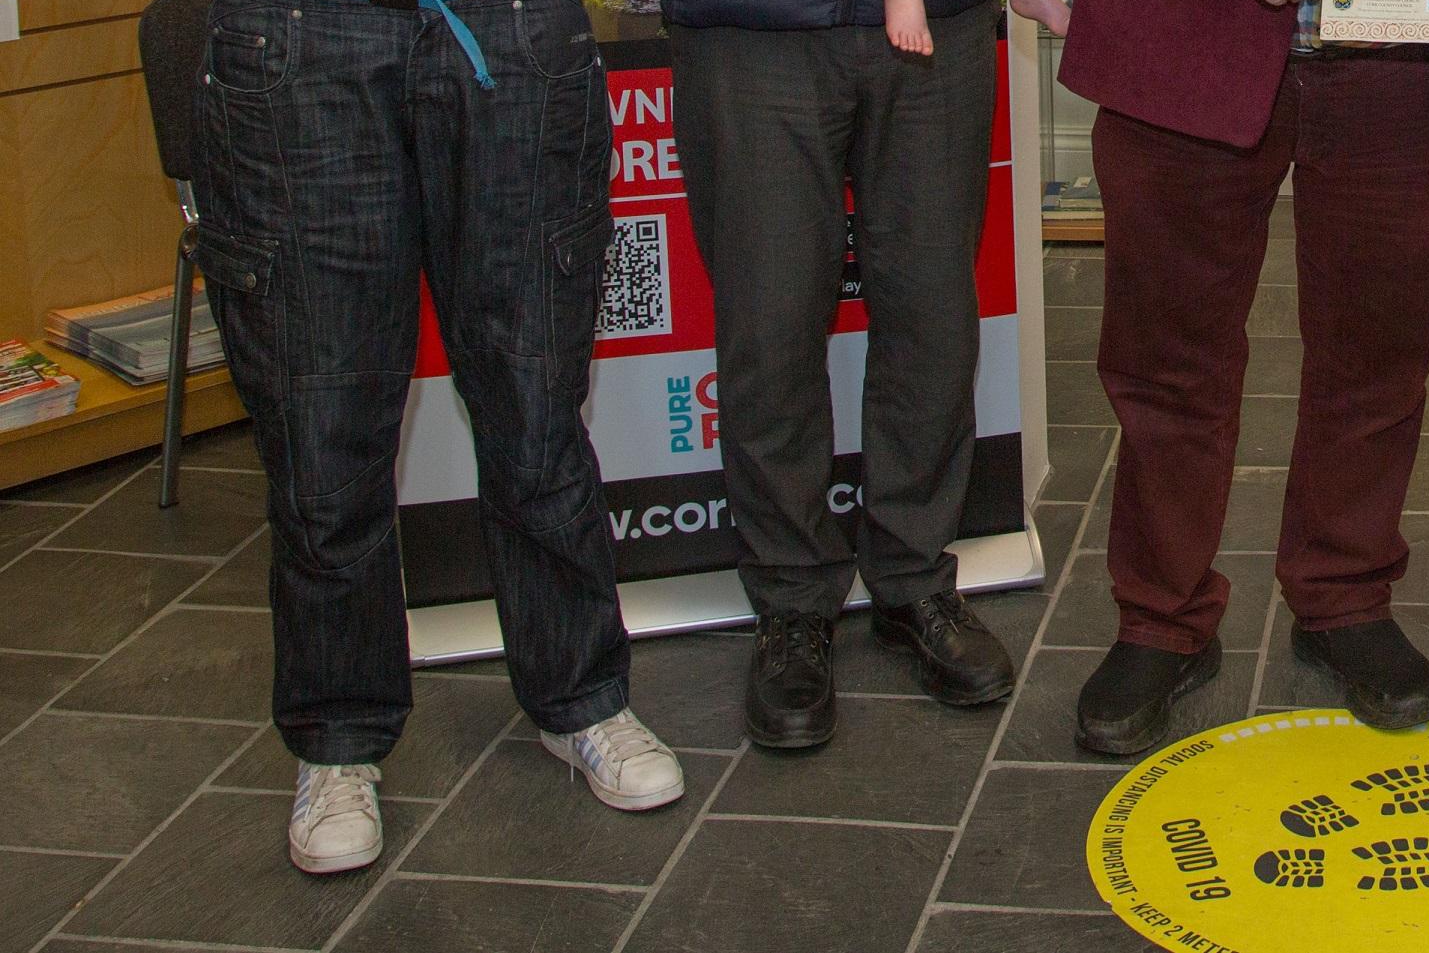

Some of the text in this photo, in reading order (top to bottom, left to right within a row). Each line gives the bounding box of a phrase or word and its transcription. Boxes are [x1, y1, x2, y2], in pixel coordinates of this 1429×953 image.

[842, 278, 862, 296] lay
[667, 375, 694, 454] PURE
[1160, 739, 1215, 767] SOCIAL
[1108, 766, 1169, 823] DISTANCING
[1104, 824, 1126, 834] IS
[1102, 837, 1139, 896] IMPORTANT
[1161, 818, 1232, 902] COVID 19
[1129, 902, 1172, 927] KEEP
[1163, 924, 1184, 938] 2
[1177, 930, 1240, 953] METE
